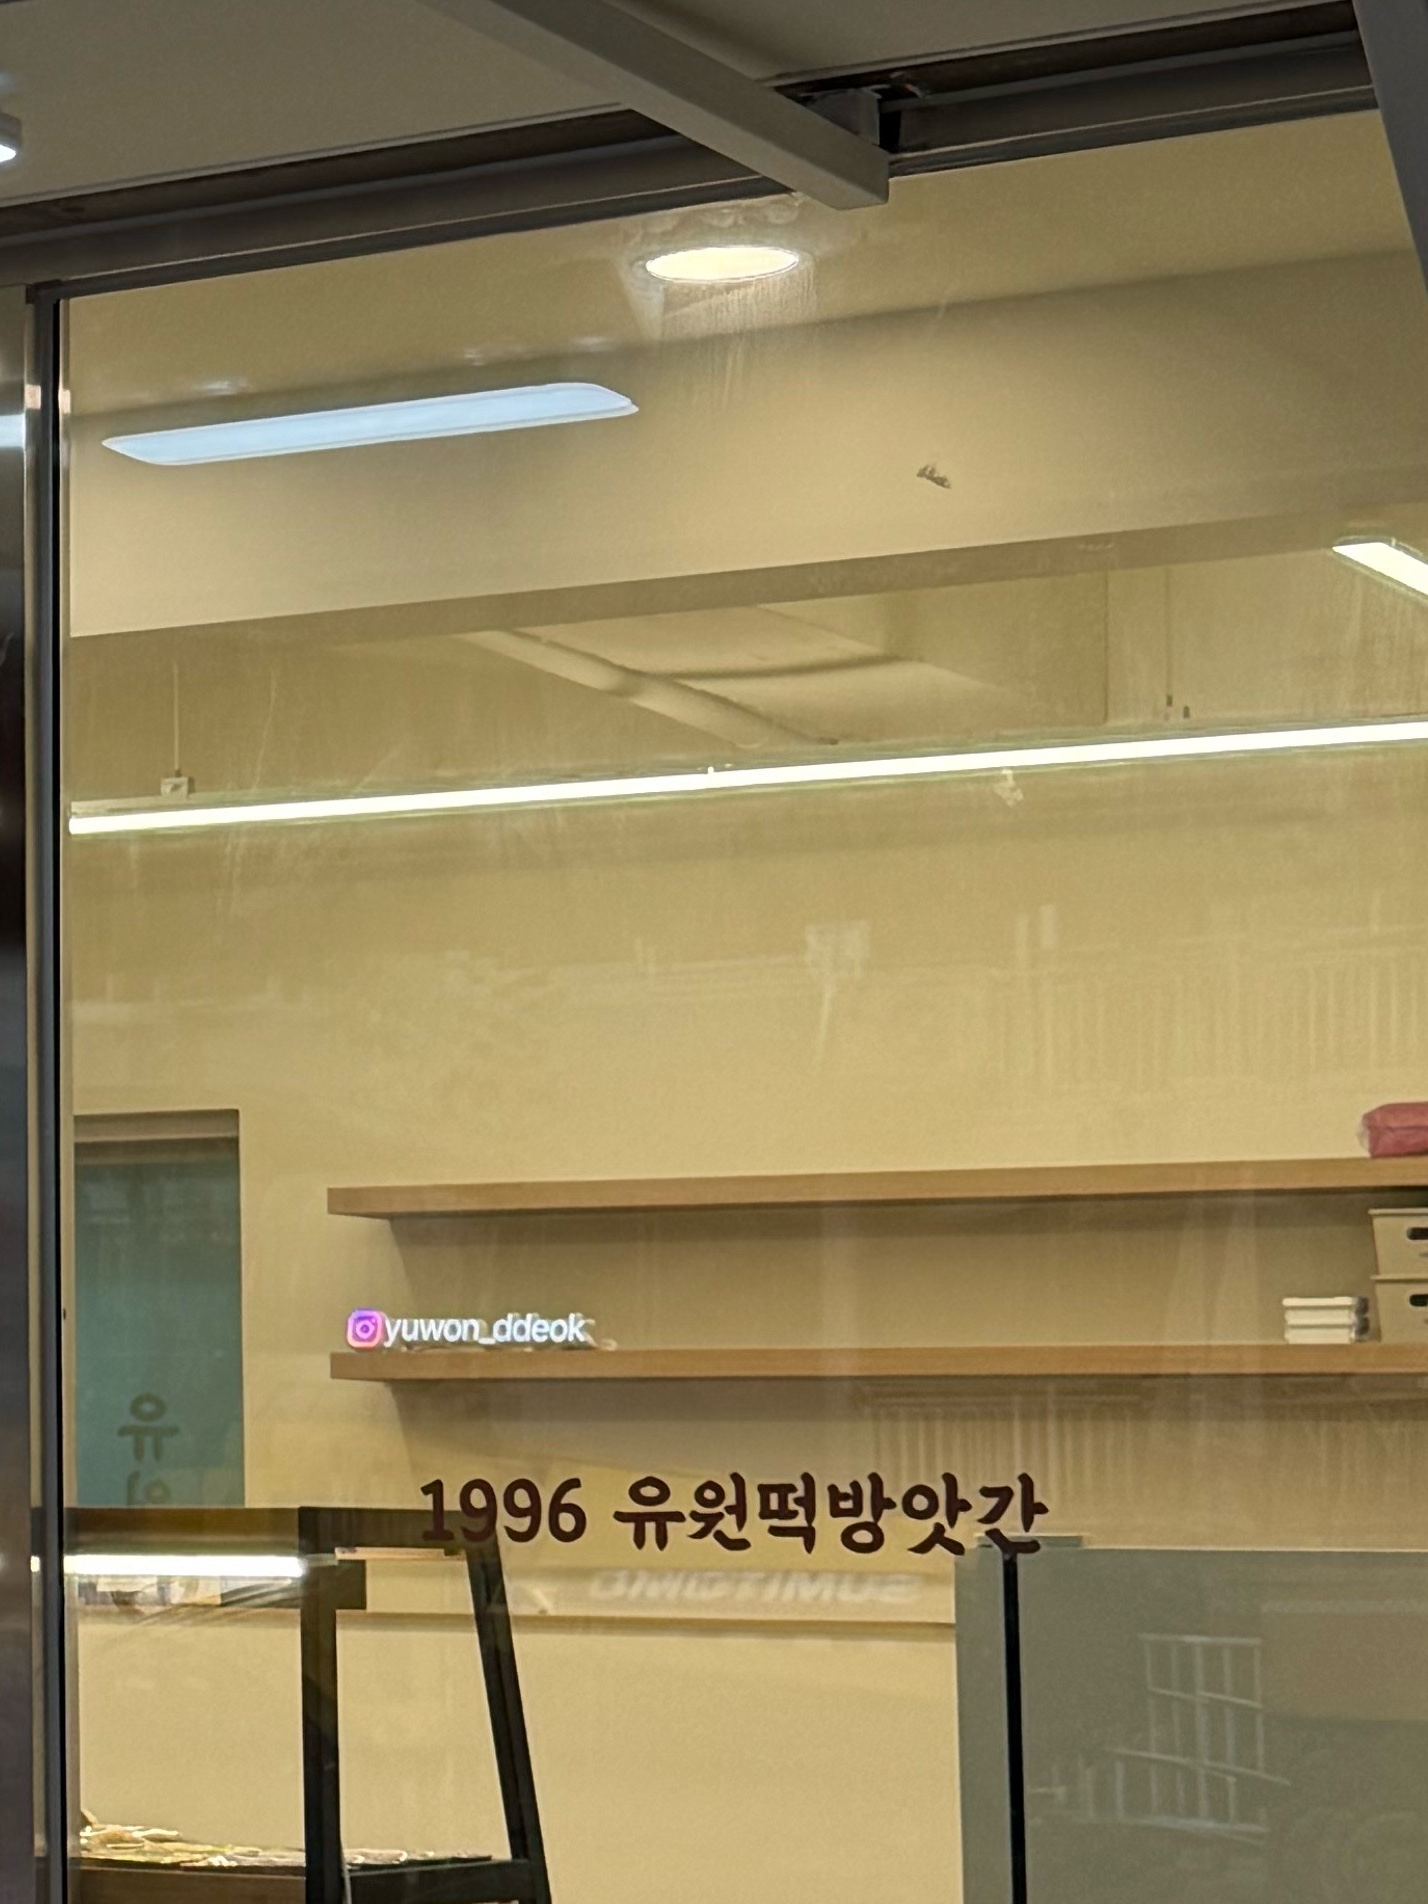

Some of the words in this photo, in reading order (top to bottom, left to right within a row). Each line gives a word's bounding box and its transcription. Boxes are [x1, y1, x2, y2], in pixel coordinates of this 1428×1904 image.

[384, 1312, 585, 1348] yuwon_ddeok
[420, 1477, 587, 1543] 1996
[613, 1471, 1050, 1556] 유원떡방앗간
